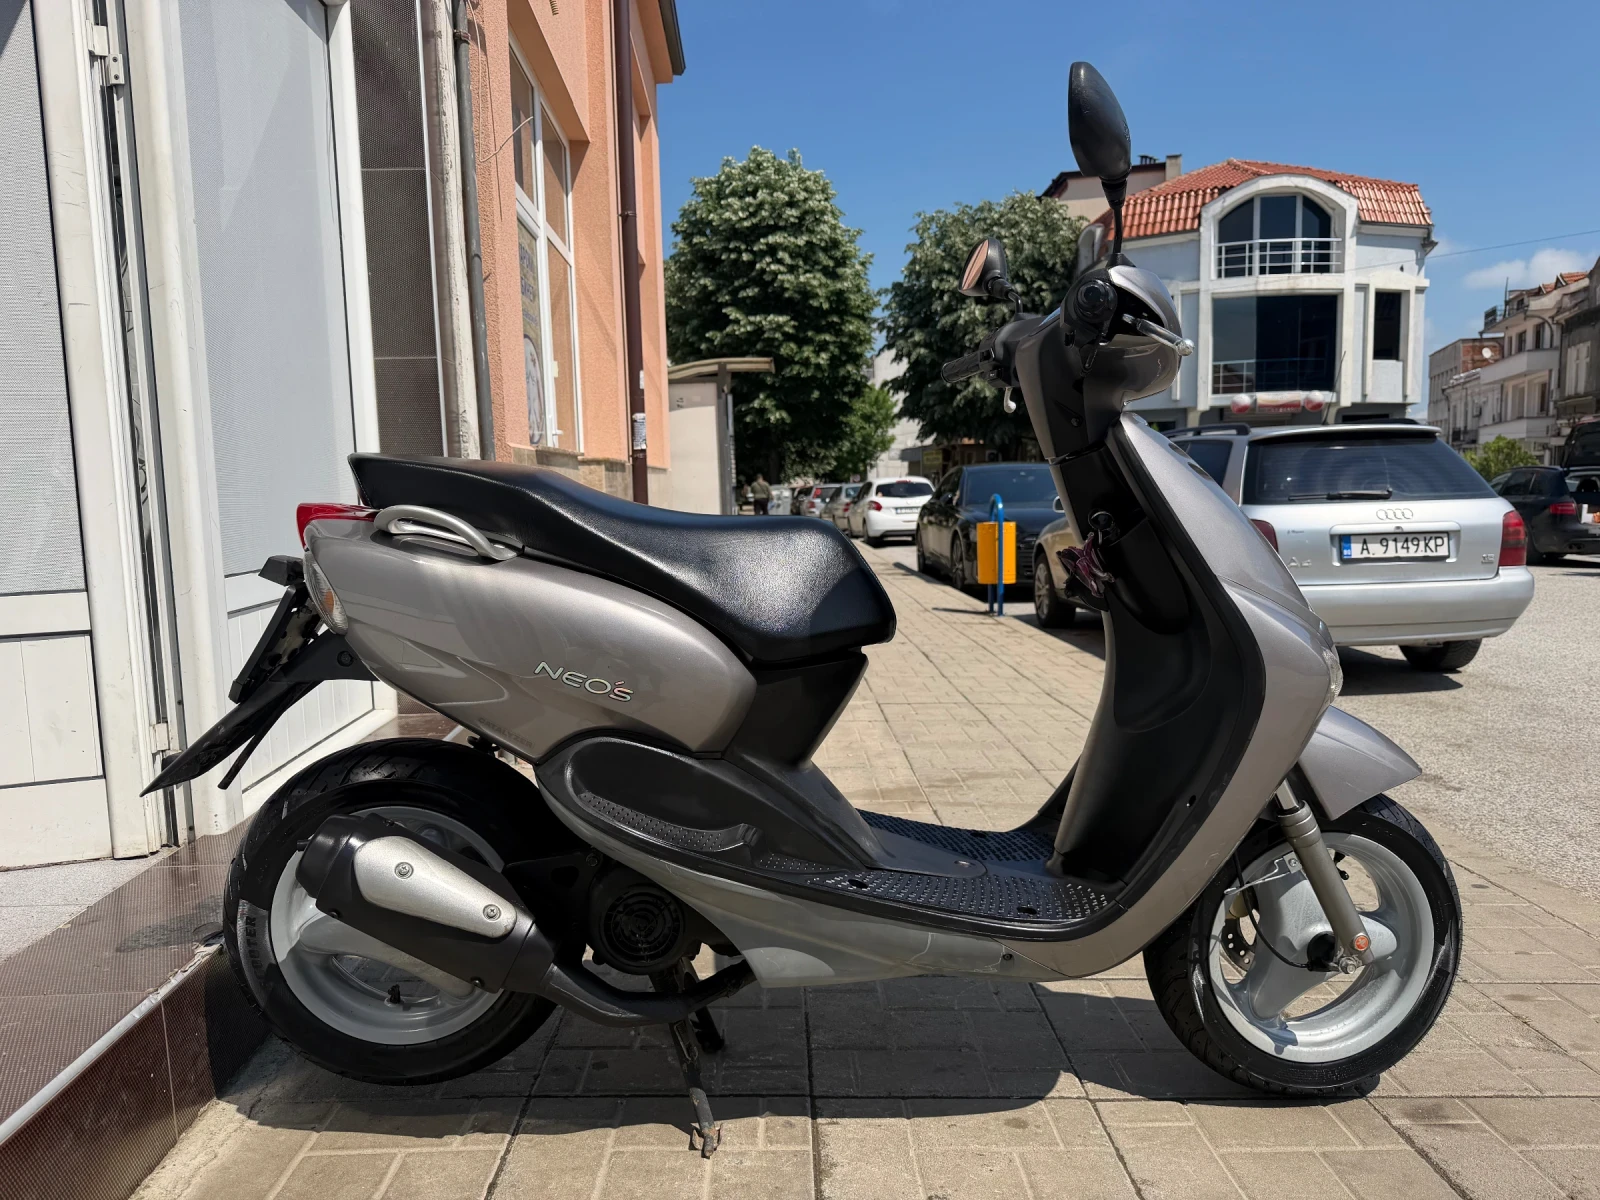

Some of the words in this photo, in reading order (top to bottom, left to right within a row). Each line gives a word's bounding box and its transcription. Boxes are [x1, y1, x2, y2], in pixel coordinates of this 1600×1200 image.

[1360, 538, 1371, 555] A
[1379, 537, 1420, 554] 9149
[1423, 536, 1445, 553] KP
[478, 717, 534, 748] CATALYZER
